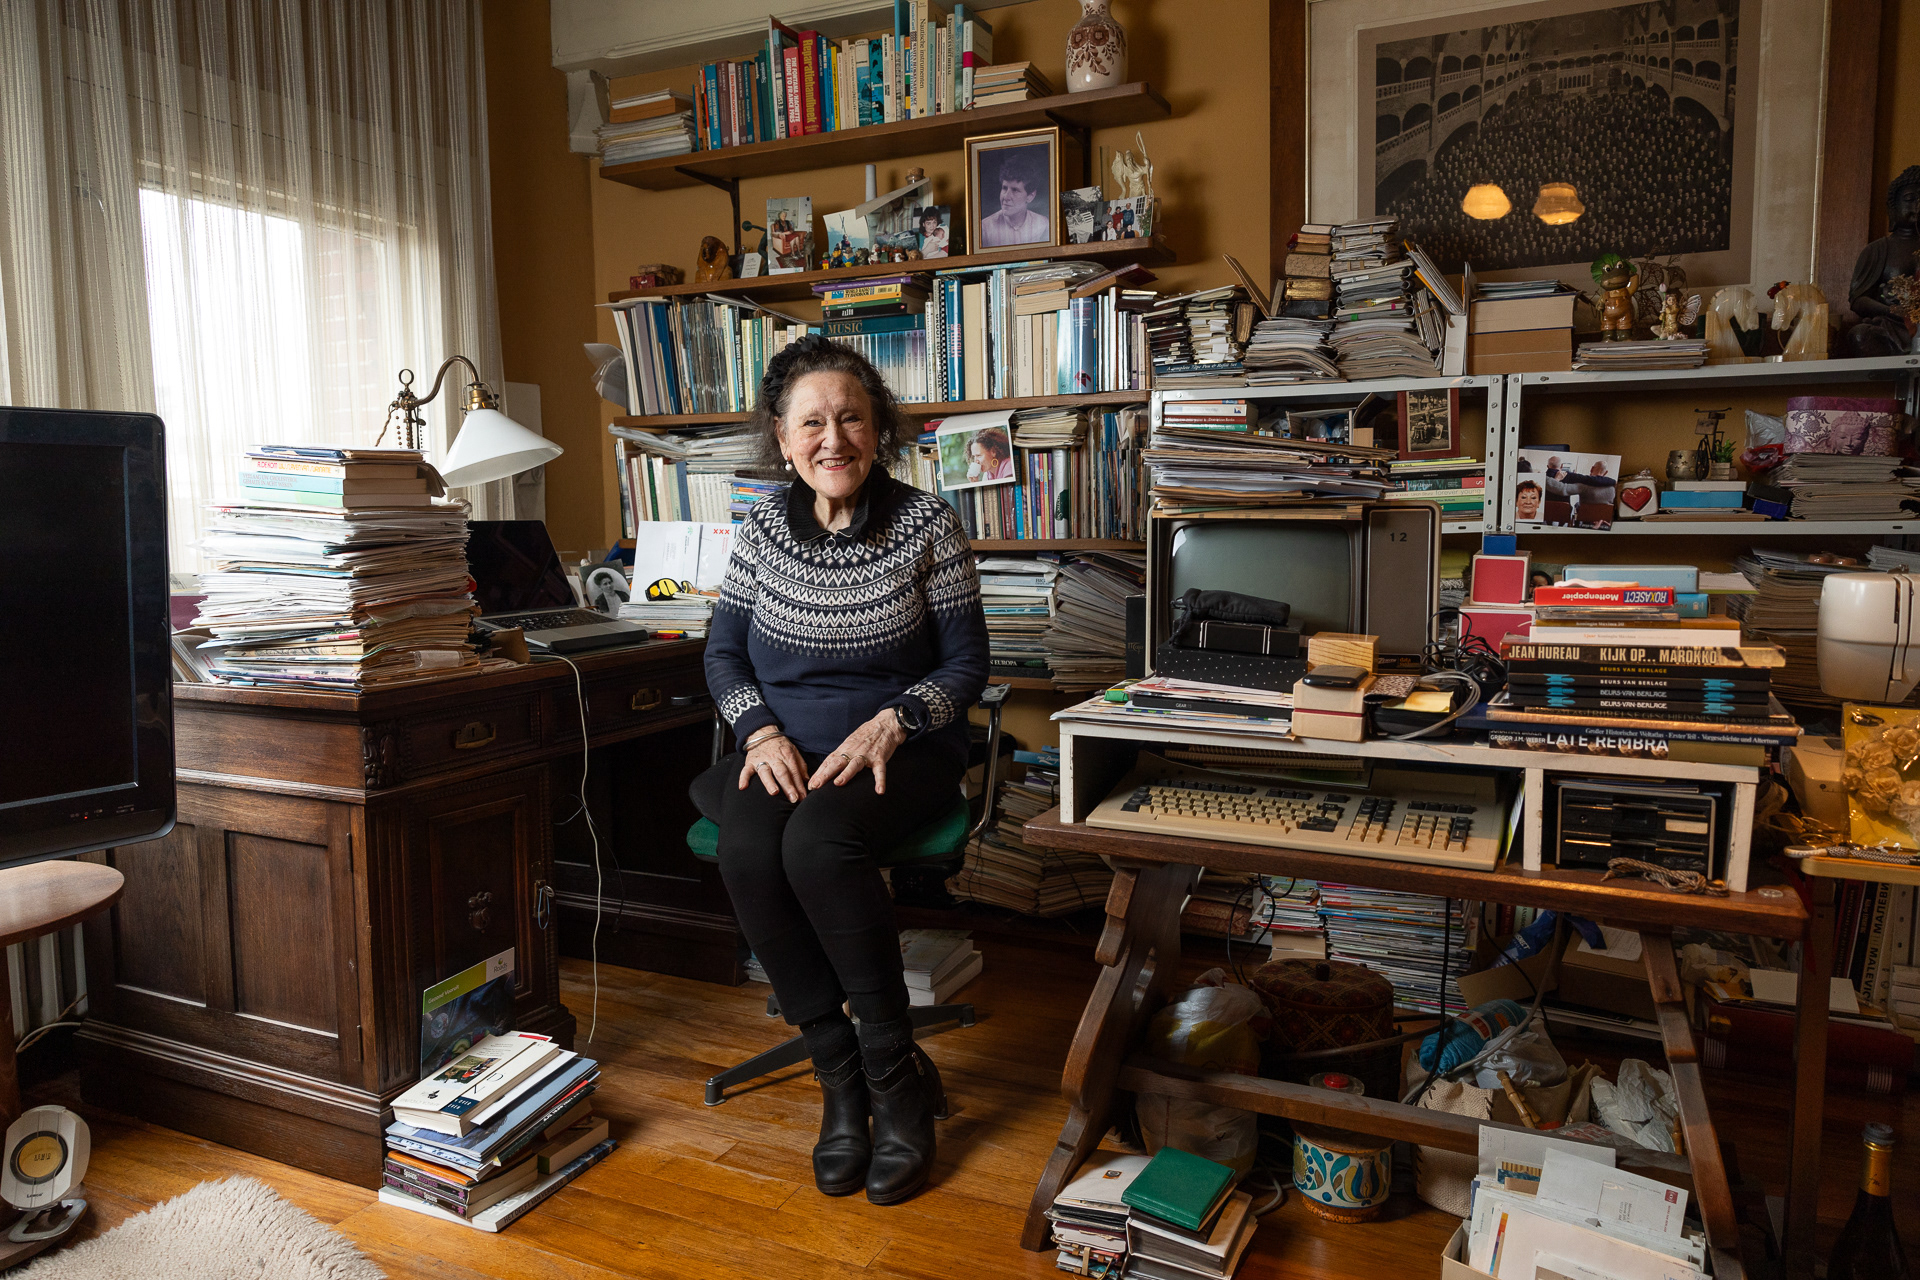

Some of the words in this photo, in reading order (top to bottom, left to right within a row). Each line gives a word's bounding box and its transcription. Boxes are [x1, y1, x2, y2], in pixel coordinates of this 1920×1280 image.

[919, 18, 927, 48] Nautische
[785, 58, 793, 76] GUIDE
[919, 49, 927, 89] instrumenten
[802, 39, 817, 124] Reparatiehandboek
[827, 321, 863, 335] MUSIC
[1460, 489, 1481, 497] young
[1399, 532, 1407, 542] 2
[1561, 592, 1619, 602] Mottenpapier
[1624, 591, 1667, 603] ROXASECT
[1509, 645, 1536, 659] JEAN
[1538, 646, 1580, 660] HUREAU
[1600, 647, 1627, 661] KIJK
[1630, 648, 1657, 662] OP...
[1659, 649, 1718, 664] MAROKKO
[994, 659, 1018, 667] EUROPA
[1513, 735, 1525, 743] J.M.
[1546, 733, 1588, 747] LATE
[1639, 730, 1664, 738] Weltatlas
[1702, 733, 1740, 743] Vorgeschichte
[1753, 737, 1779, 745] Altertum
[503, 1212, 516, 1224] HET
[515, 1201, 532, 1216] DELFT
[531, 1194, 542, 1206] VAN
[541, 1179, 565, 1201] VERMEER
